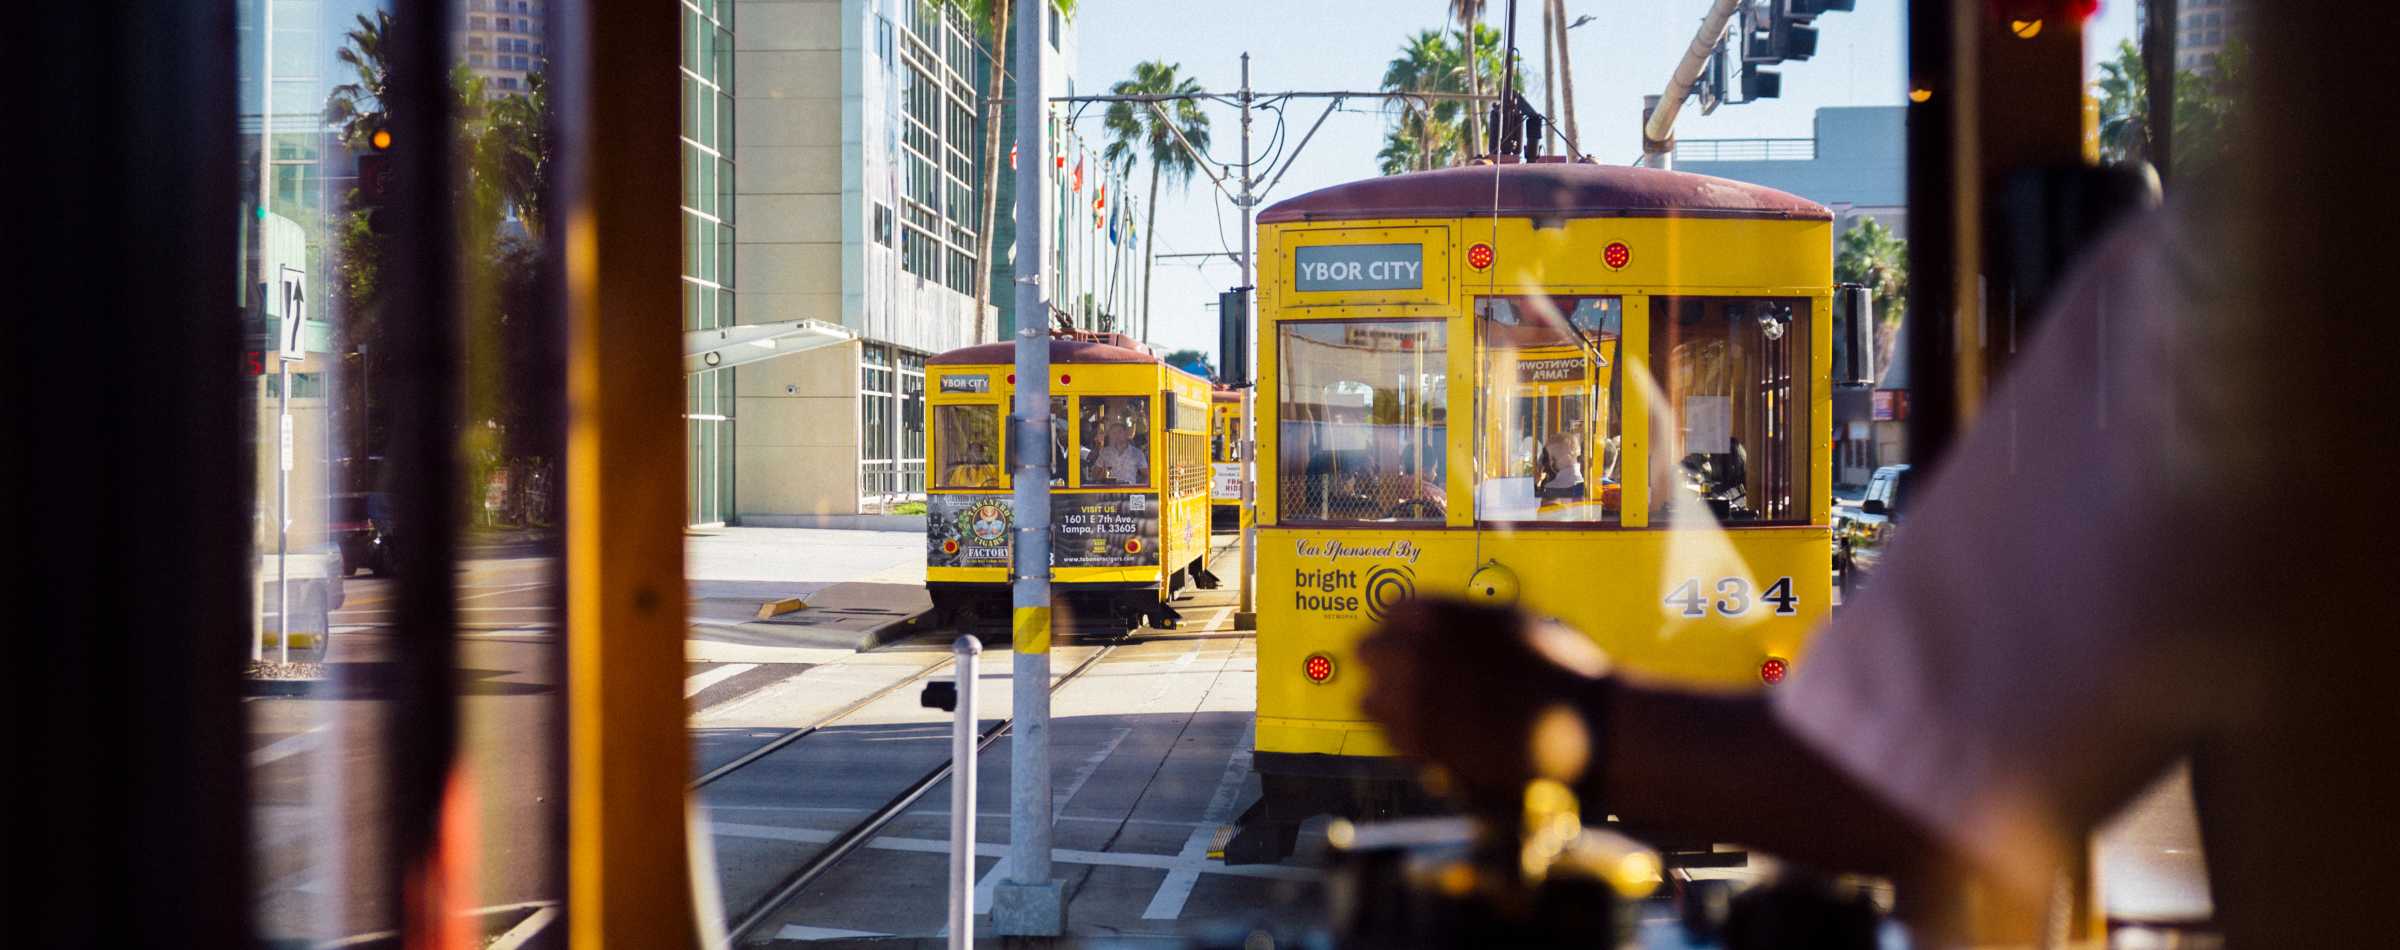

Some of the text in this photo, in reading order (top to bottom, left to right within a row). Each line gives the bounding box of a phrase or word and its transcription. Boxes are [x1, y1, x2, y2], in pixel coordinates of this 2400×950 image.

[1302, 261, 1419, 281] YBOR CITY
[943, 378, 989, 388] YBOR CITY
[1081, 505, 1116, 513] VISIT US
[1065, 515, 1134, 524] 1601 E 7th Ave.
[1062, 524, 1136, 535] Tampa, FL 33605
[974, 537, 1004, 547] CIGARS
[968, 548, 1009, 557] FACTORY
[1296, 539, 1421, 564] Car Sponsored By
[1296, 569, 1357, 592] bright
[1296, 591, 1359, 611] house
[1664, 576, 1799, 617] 434
